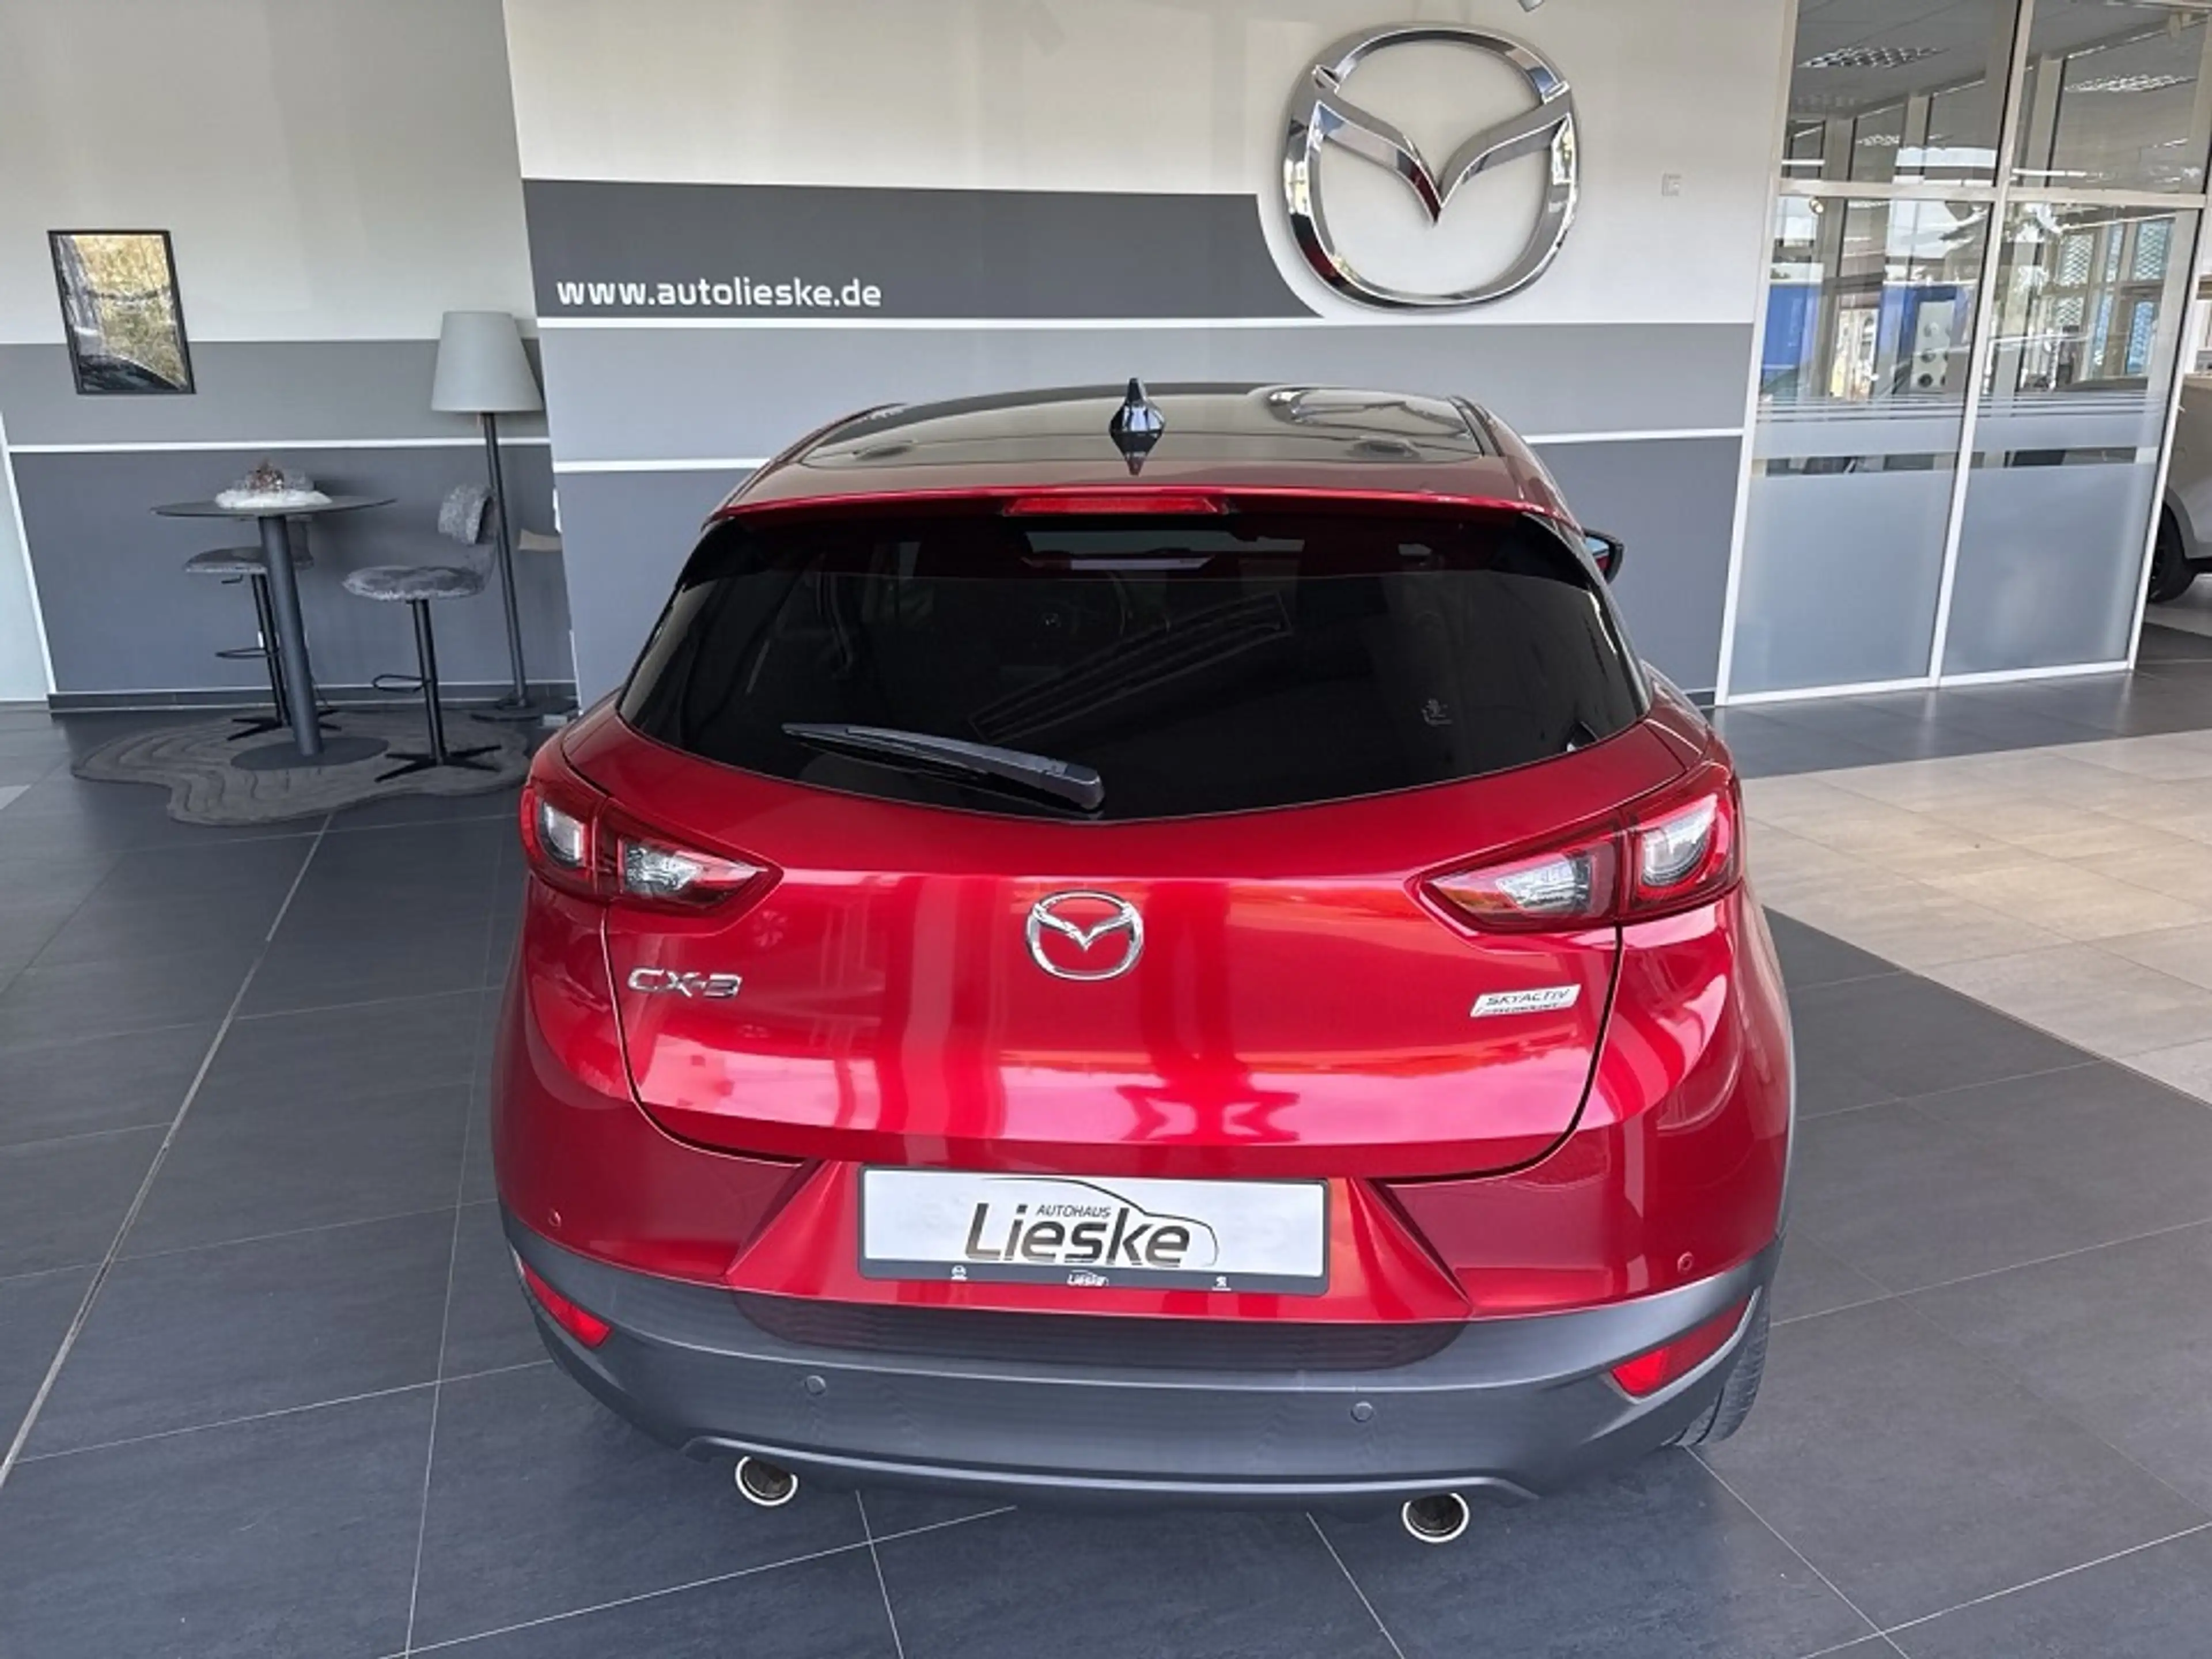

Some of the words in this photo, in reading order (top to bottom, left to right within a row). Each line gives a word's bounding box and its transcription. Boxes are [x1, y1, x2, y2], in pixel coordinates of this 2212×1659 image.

[556, 277, 882, 307] www.autolieske.de
[627, 968, 743, 997] CX-3
[1036, 1204, 1112, 1219] AUTOHAUS
[965, 1202, 1191, 1268] Lieske
